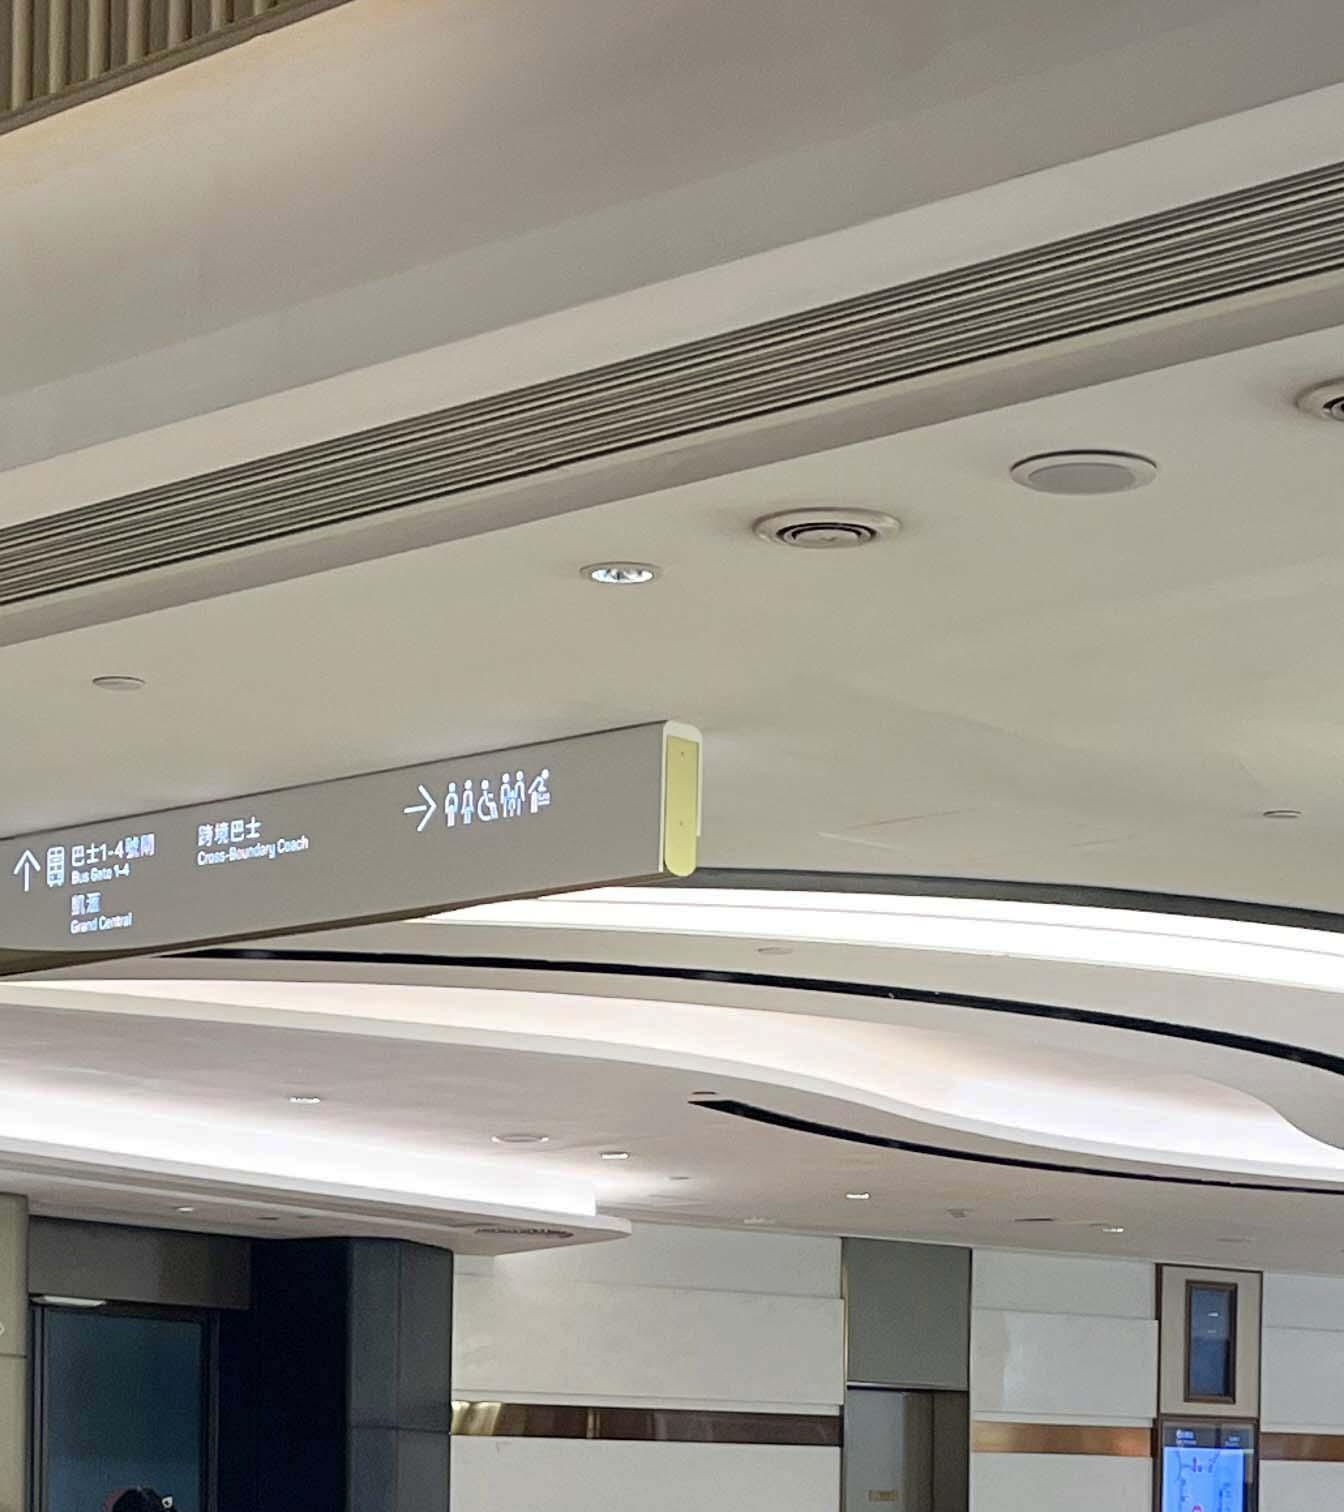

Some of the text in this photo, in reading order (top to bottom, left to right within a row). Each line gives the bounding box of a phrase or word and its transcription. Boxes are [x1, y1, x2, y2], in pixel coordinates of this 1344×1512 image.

[197, 817, 262, 847] 跨境巴士
[197, 835, 309, 866] Cross-Boundary Coach
[71, 871, 88, 885] Bus
[90, 867, 112, 882] Gate
[70, 911, 133, 934] Grand Central
